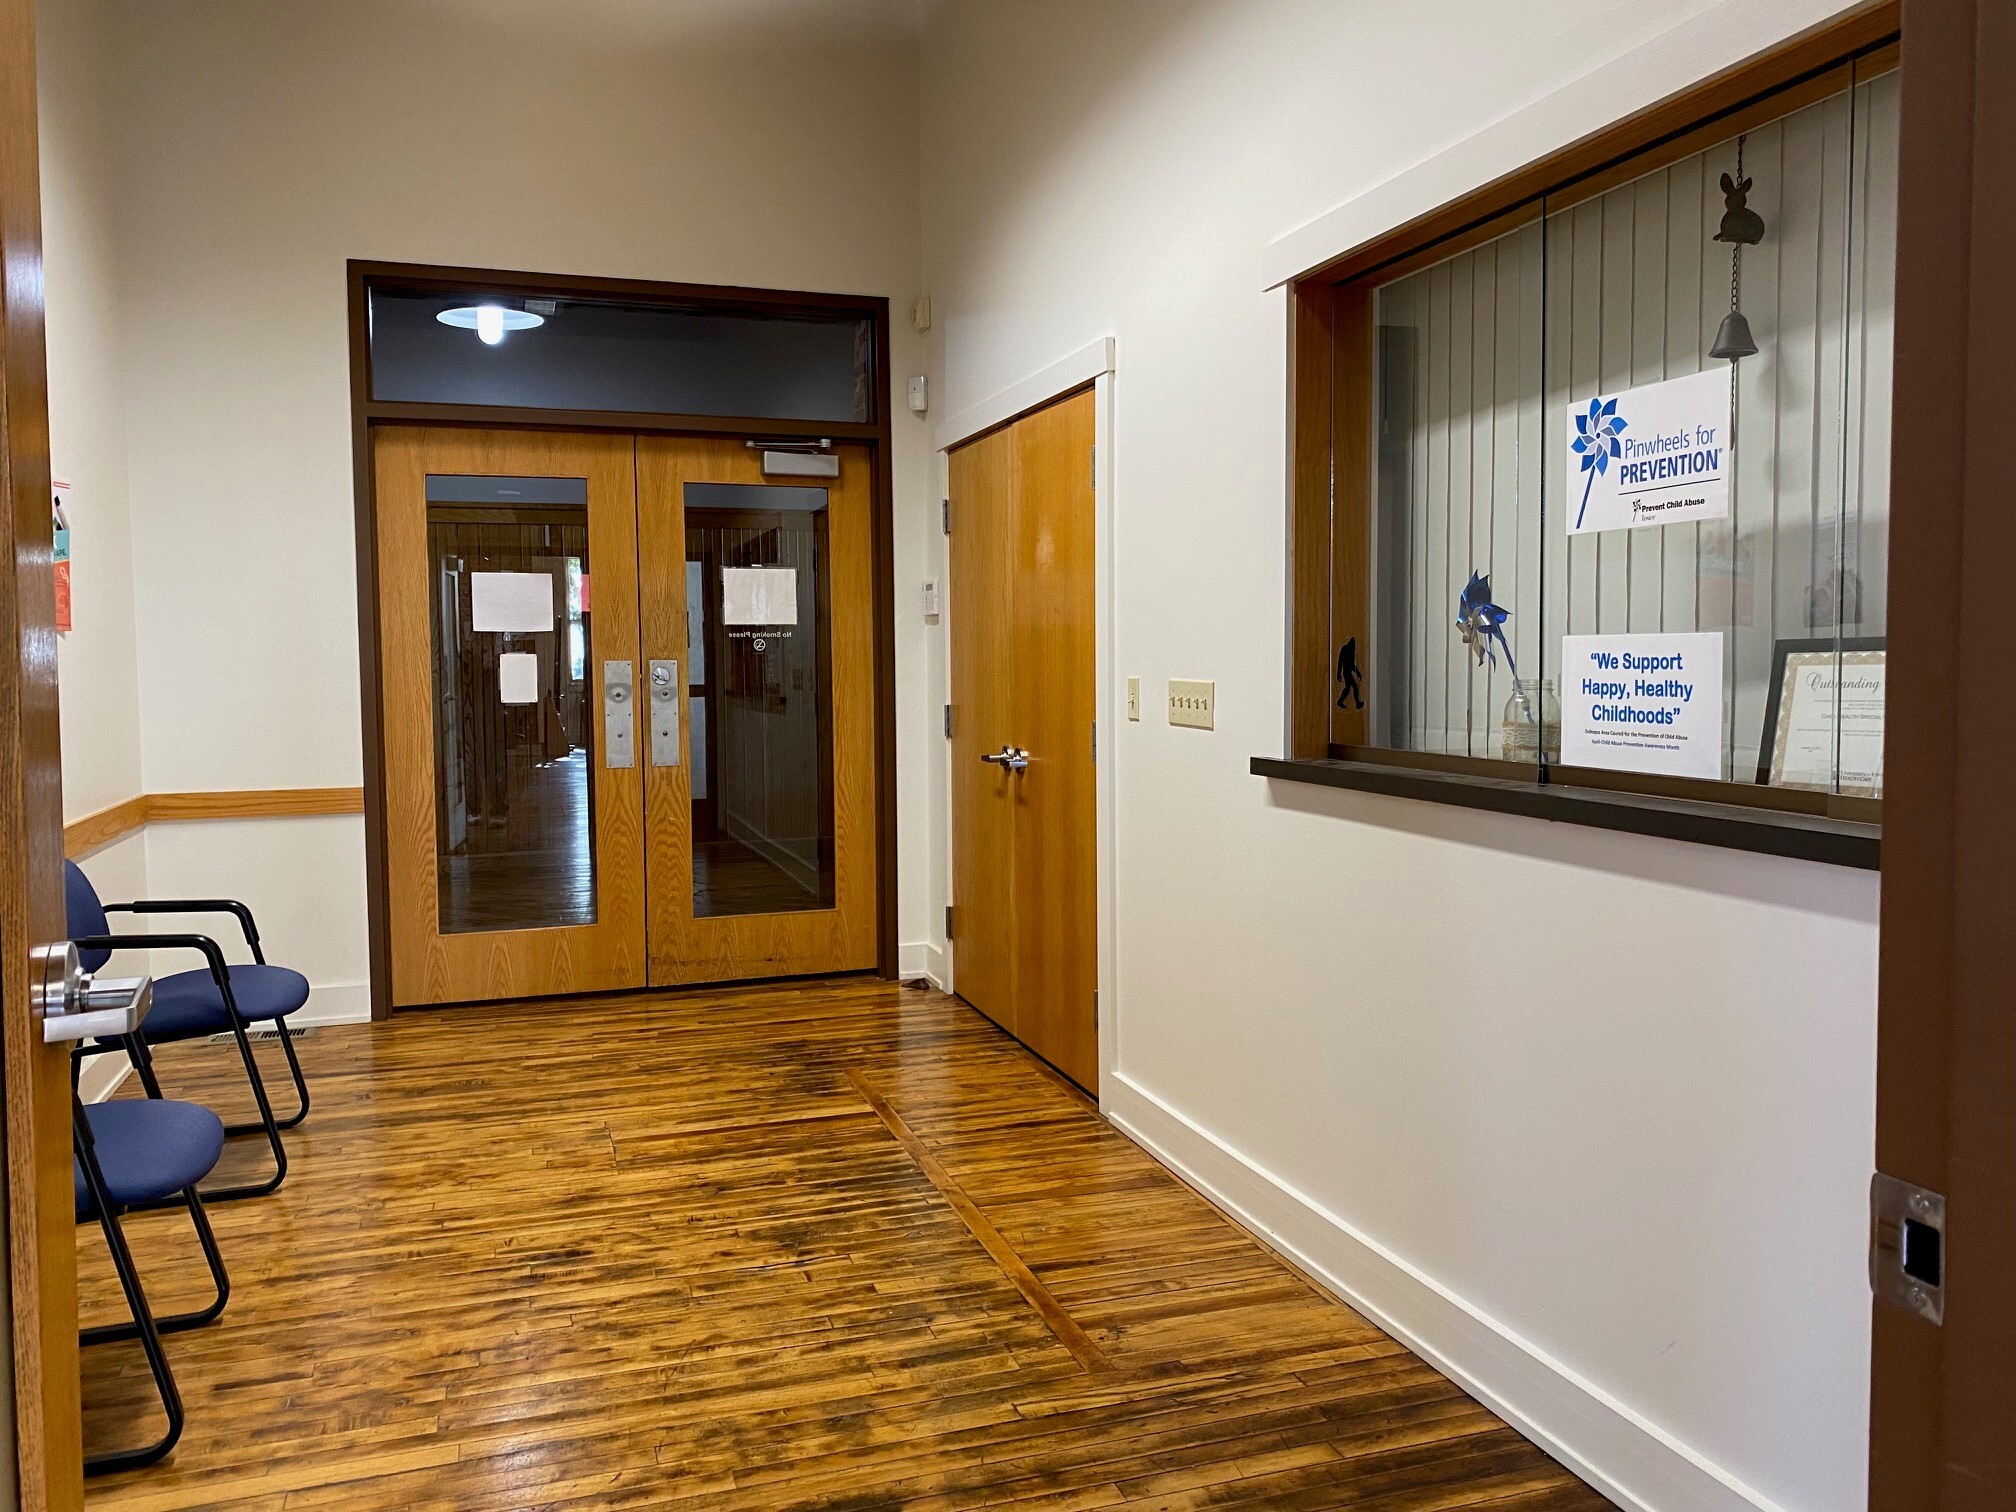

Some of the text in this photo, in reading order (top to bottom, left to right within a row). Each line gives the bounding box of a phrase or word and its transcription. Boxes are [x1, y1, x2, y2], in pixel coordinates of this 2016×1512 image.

[1625, 424, 1716, 459] Pinwheels for
[1641, 498, 1705, 512] Prevent Child Abuse
[1590, 652, 1683, 674] “We Support
[1582, 678, 1693, 702] Happy, Healthy
[1591, 704, 1680, 725] Childhoods”
